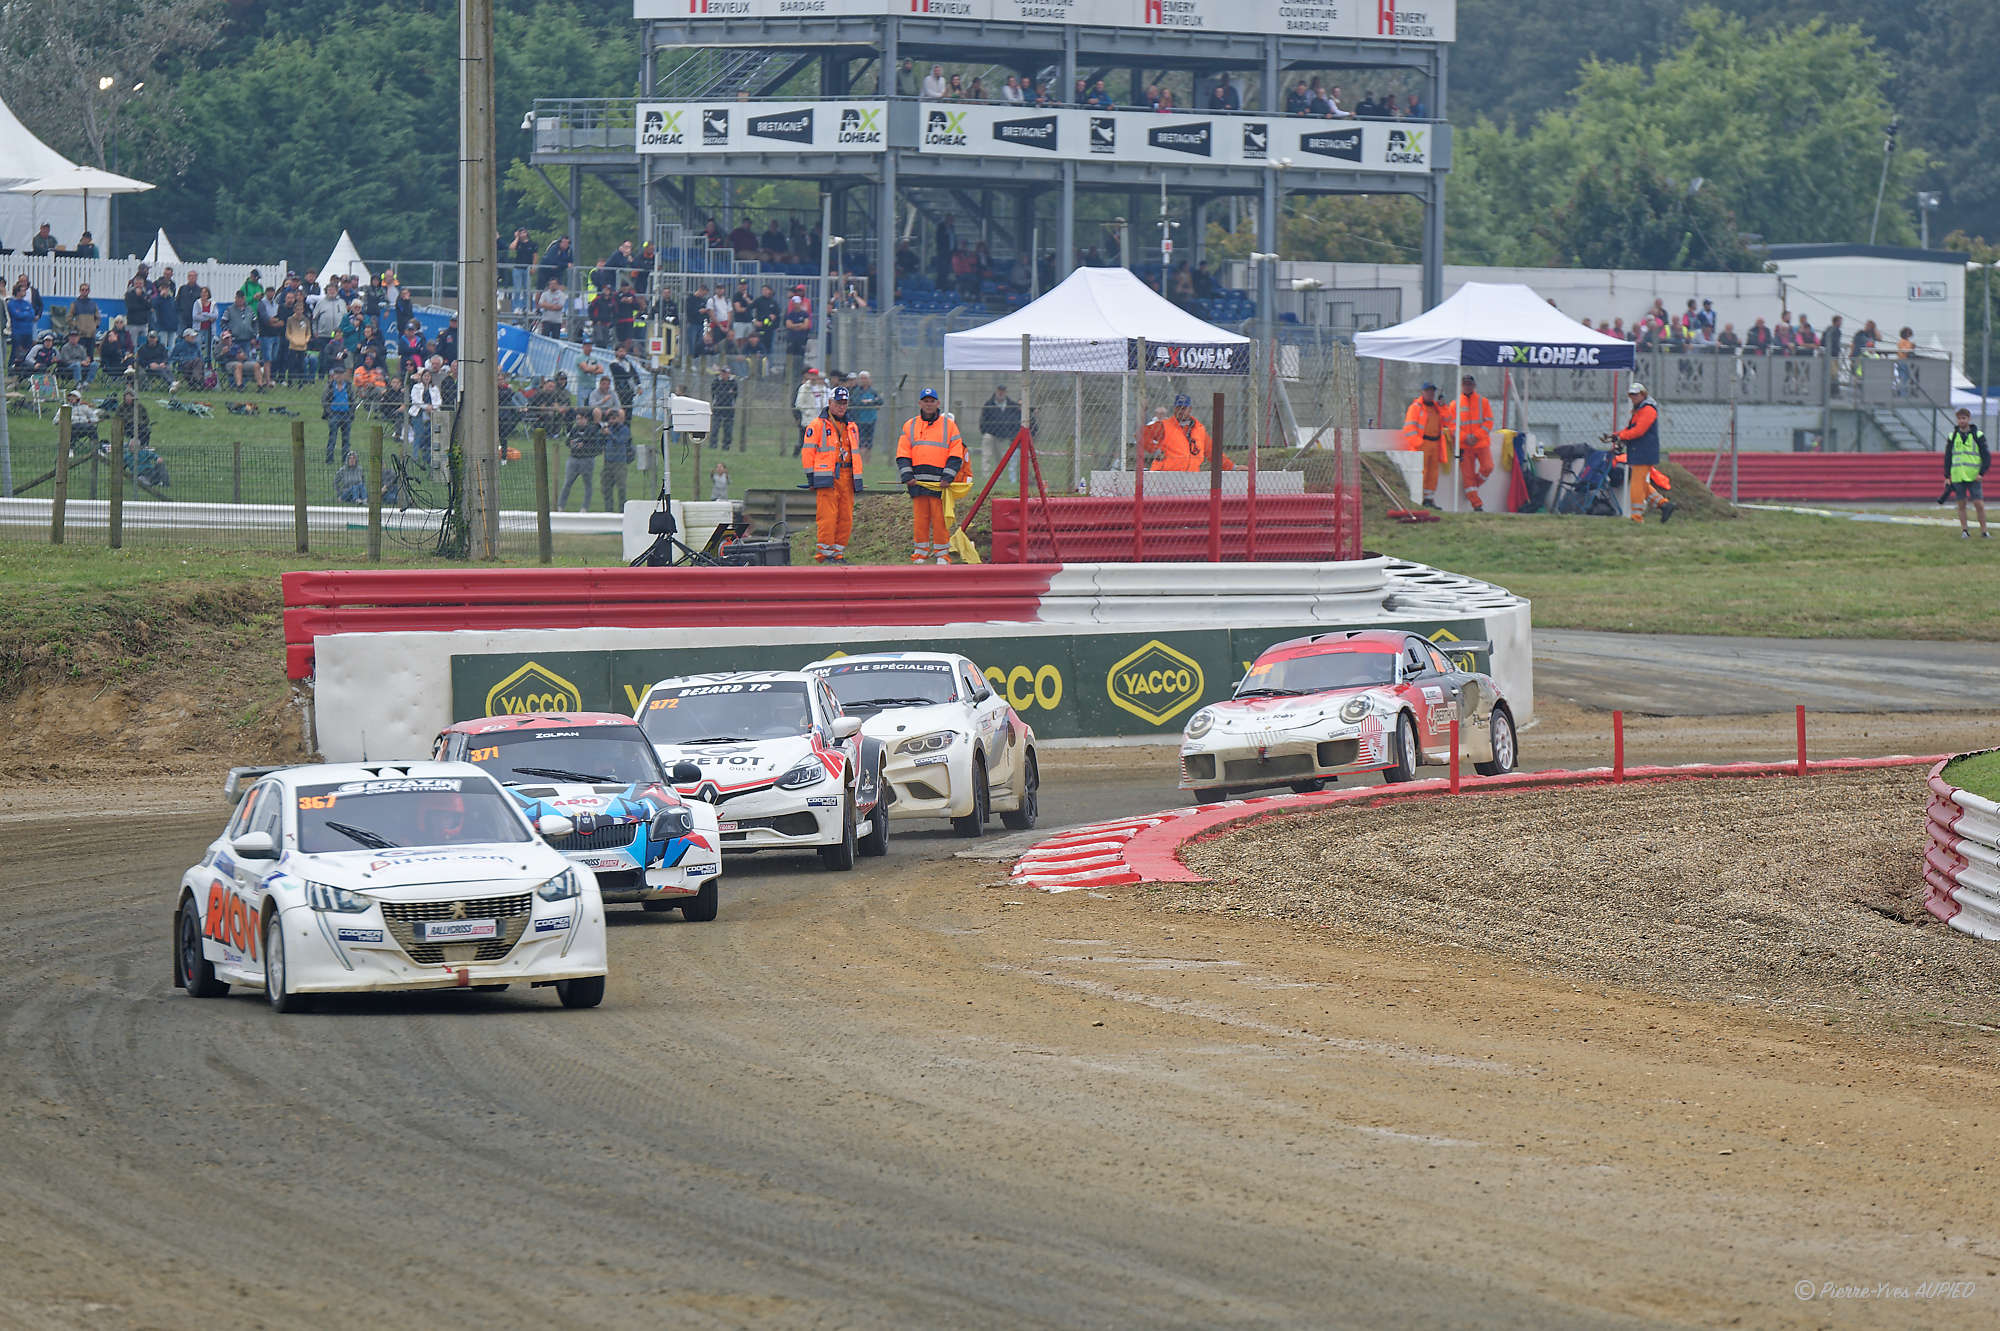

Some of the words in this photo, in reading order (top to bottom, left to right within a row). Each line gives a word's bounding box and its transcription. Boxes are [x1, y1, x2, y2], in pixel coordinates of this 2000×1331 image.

[1279, 7, 1337, 19] COUVERTURE
[1287, 20, 1329, 32] BARDAGE
[757, 121, 803, 132] BRETAGNE
[1002, 126, 1047, 138] BRETAGNE
[642, 134, 684, 145] LOHEAC
[838, 132, 881, 143] LOHEAC
[925, 133, 967, 146] LOHEAC
[1385, 153, 1424, 165] LOHEAC
[873, 662, 950, 672] SPÉCIALISTE
[984, 664, 1063, 711] CCO
[1122, 669, 1191, 695] YACCO
[678, 684, 744, 697] BEZARD
[748, 683, 773, 692] TP
[501, 692, 568, 715] YACCO
[649, 698, 680, 711] 372
[535, 731, 580, 739] ZOLPAN
[470, 746, 499, 762] 371
[299, 795, 338, 810] 367
[686, 864, 716, 872] COOPER
[536, 916, 570, 927] COOPER
[338, 929, 383, 938] COOPER
[430, 924, 472, 936] RALLYCROSS
